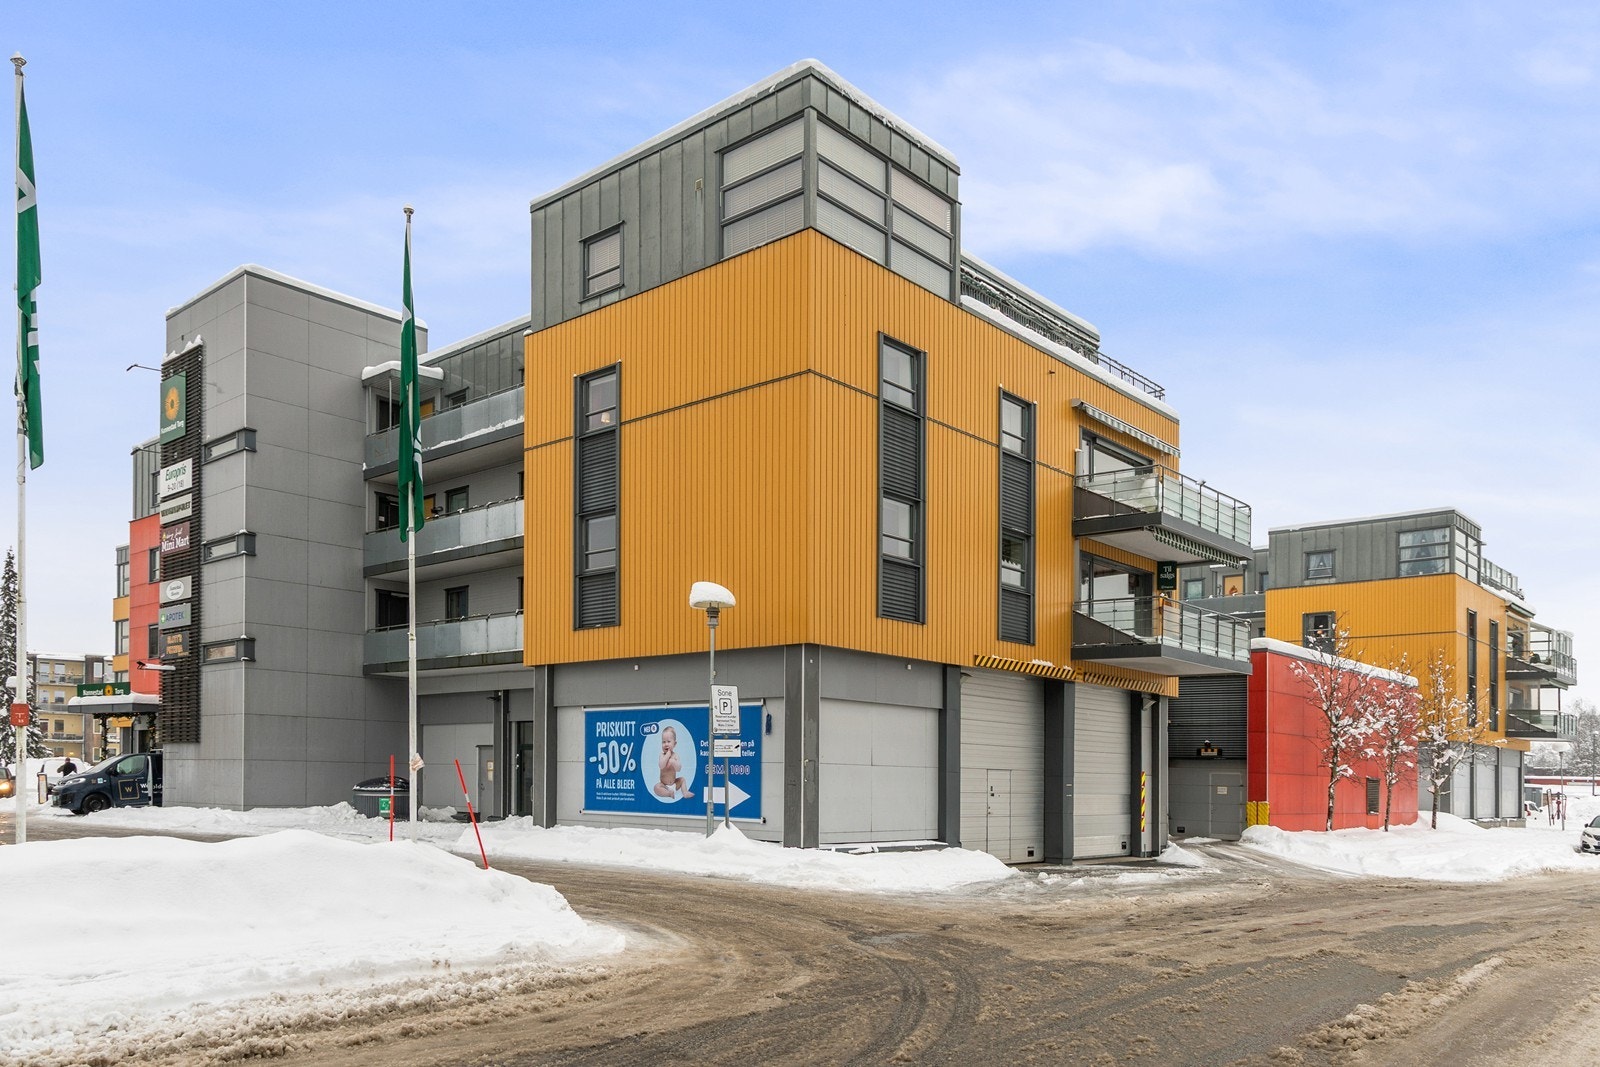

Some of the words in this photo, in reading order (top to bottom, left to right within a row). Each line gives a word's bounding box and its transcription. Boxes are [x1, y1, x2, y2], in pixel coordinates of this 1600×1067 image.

[165, 463, 187, 482] Europris
[161, 539, 175, 552] Mini
[175, 535, 189, 548] Mart
[166, 611, 184, 622] APOTEK
[114, 687, 124, 696] Torg
[717, 688, 732, 697] Sone
[722, 701, 728, 711] P
[596, 721, 636, 737] PRISKUTT
[748, 739, 755, 748] på
[589, 740, 636, 775] -50%
[741, 749, 756, 757] teller
[730, 764, 750, 775] 1000
[596, 777, 603, 789] PÅ
[603, 778, 616, 789] ALLE
[616, 779, 635, 790] BLEIER
